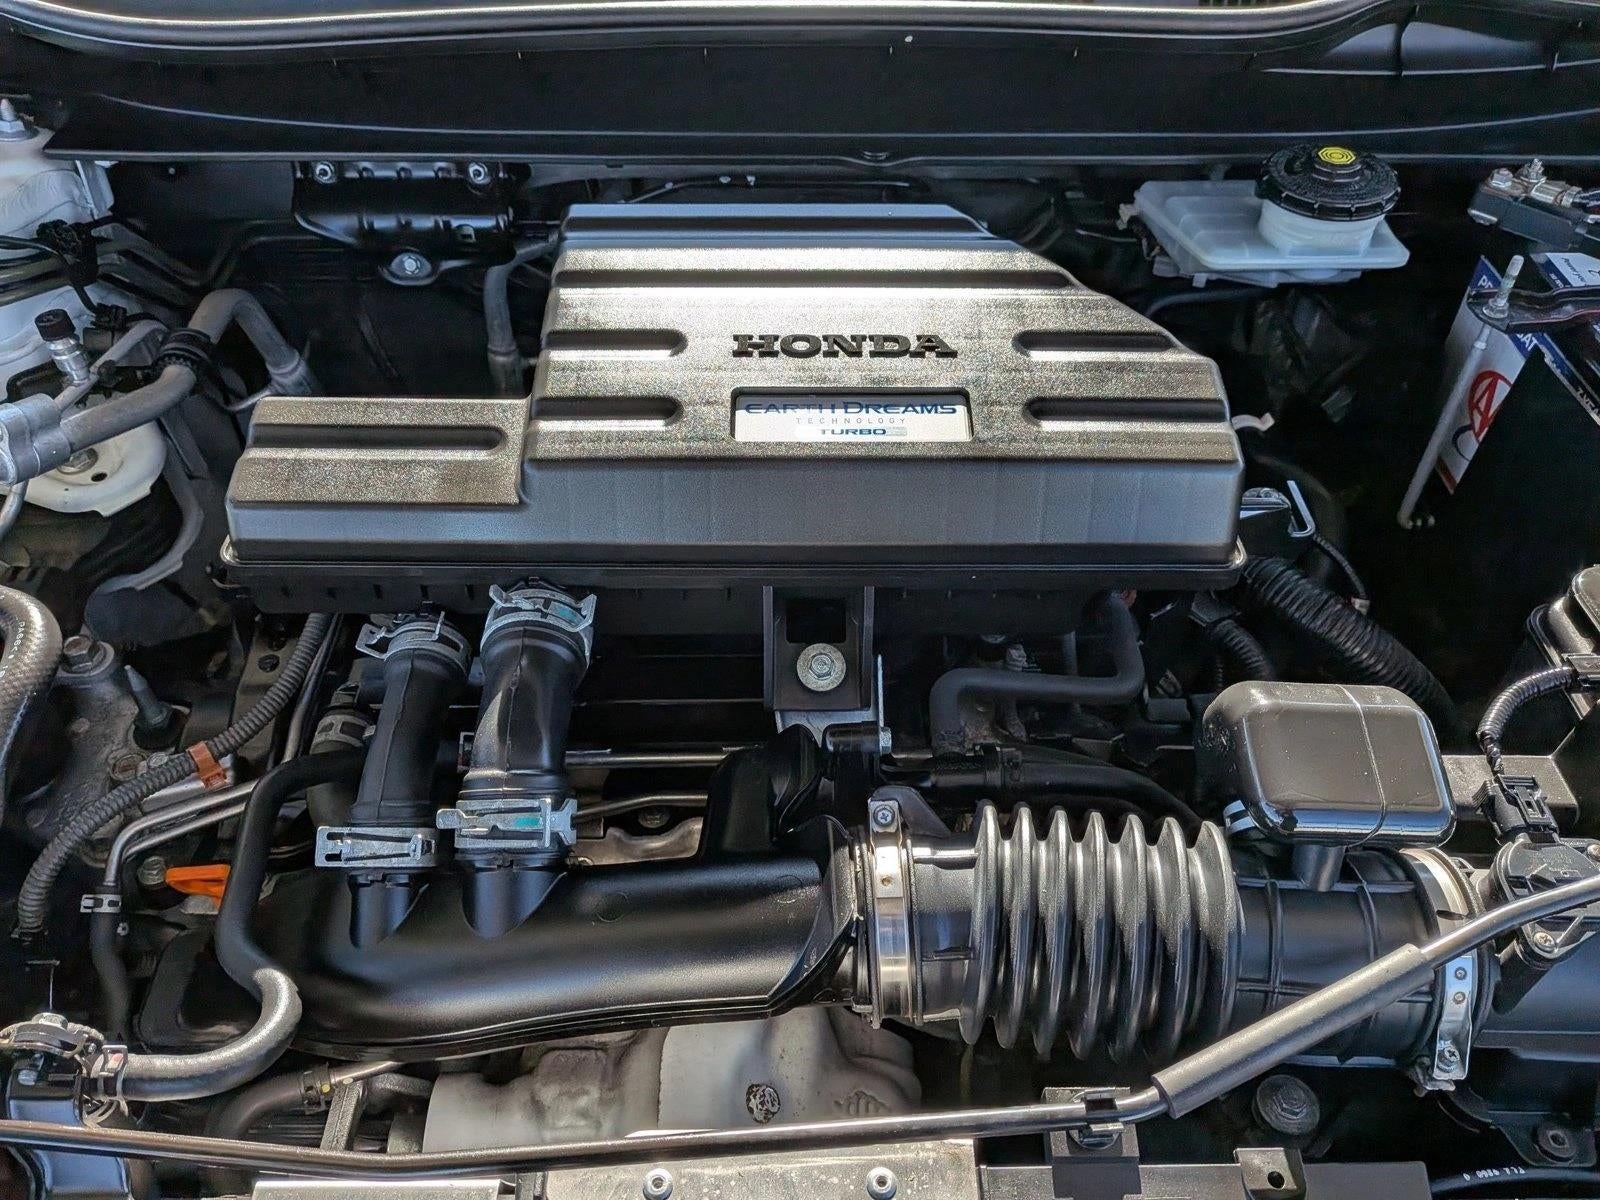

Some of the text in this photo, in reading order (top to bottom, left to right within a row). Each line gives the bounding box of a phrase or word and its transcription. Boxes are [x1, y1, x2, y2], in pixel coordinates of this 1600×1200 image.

[732, 333, 959, 358] HONDA
[744, 401, 957, 414] EARTH DREAMS
[820, 428, 887, 436] TURBO
